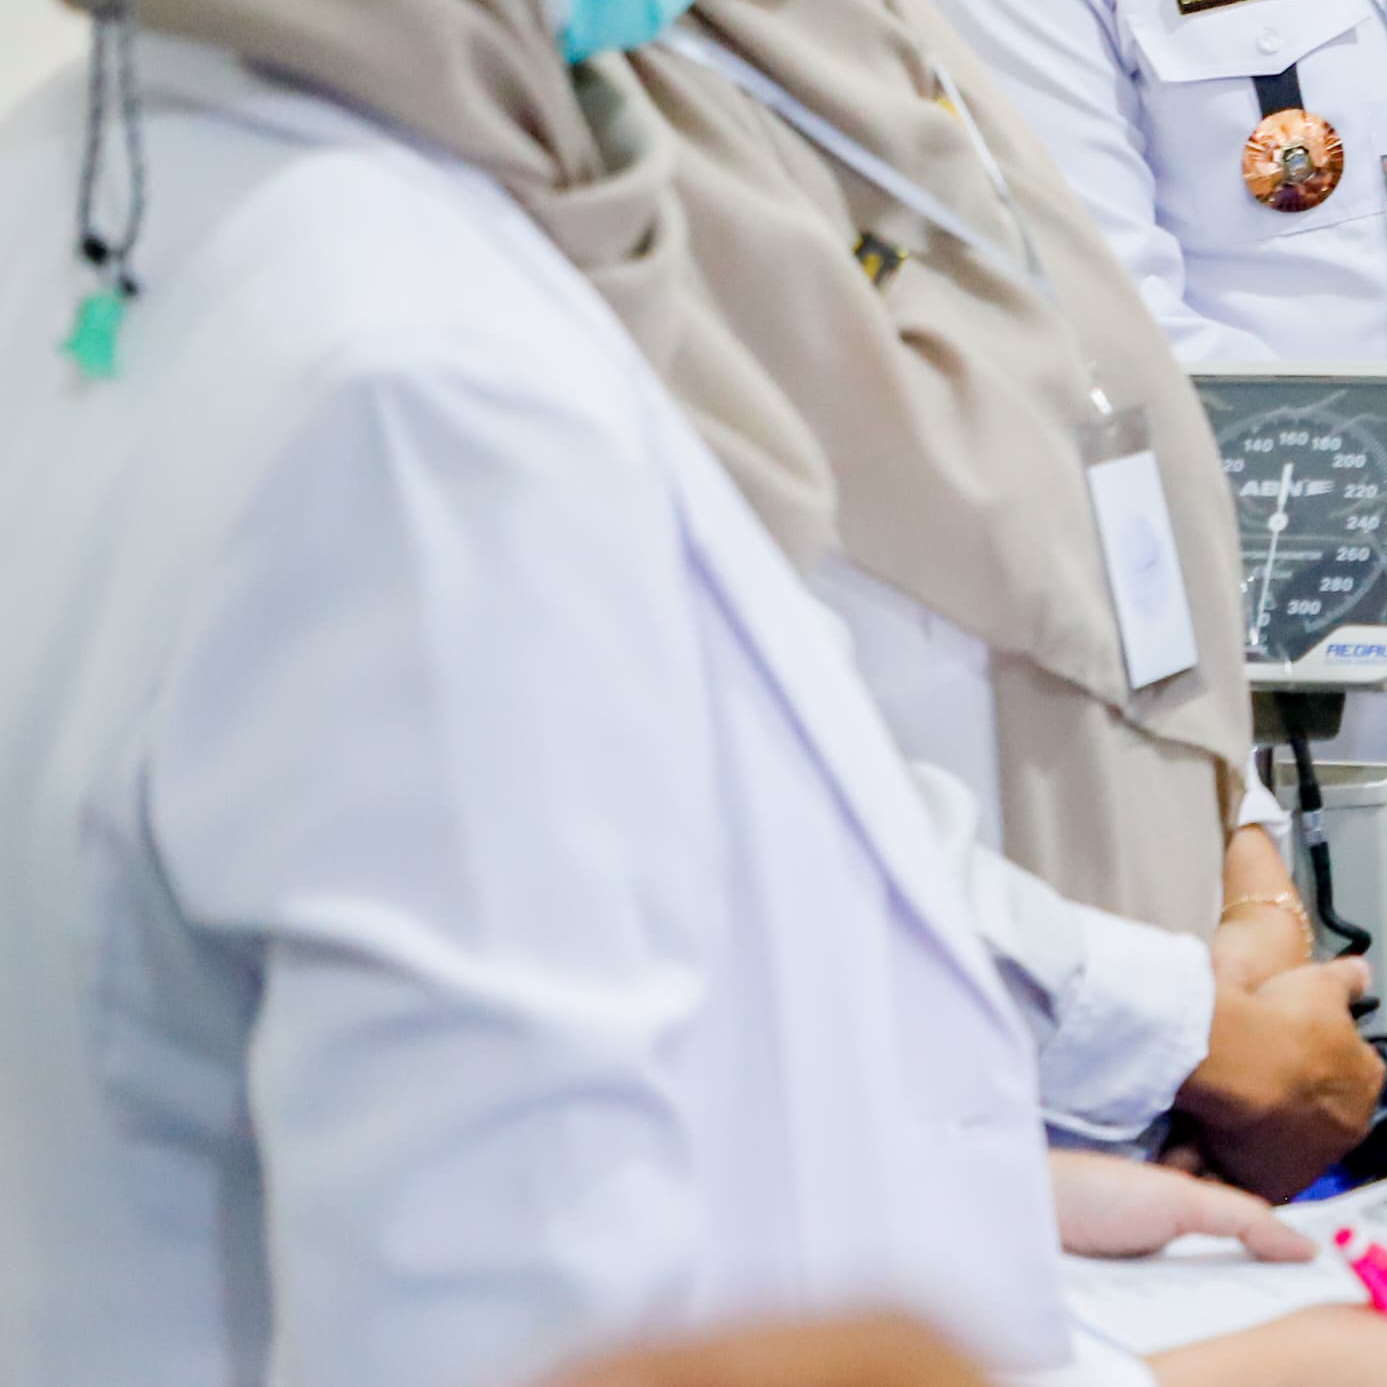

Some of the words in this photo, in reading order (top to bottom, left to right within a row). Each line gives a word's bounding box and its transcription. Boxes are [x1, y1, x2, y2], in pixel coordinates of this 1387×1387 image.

[1243, 438, 1275, 453] 140
[1279, 430, 1310, 446] 160
[1312, 436, 1342, 451] 180
[1332, 454, 1367, 468] 200
[1344, 484, 1379, 499] 220
[1346, 515, 1382, 531] 240
[1336, 546, 1371, 562] 260
[1319, 577, 1354, 592] 280
[1287, 599, 1322, 615] 300
